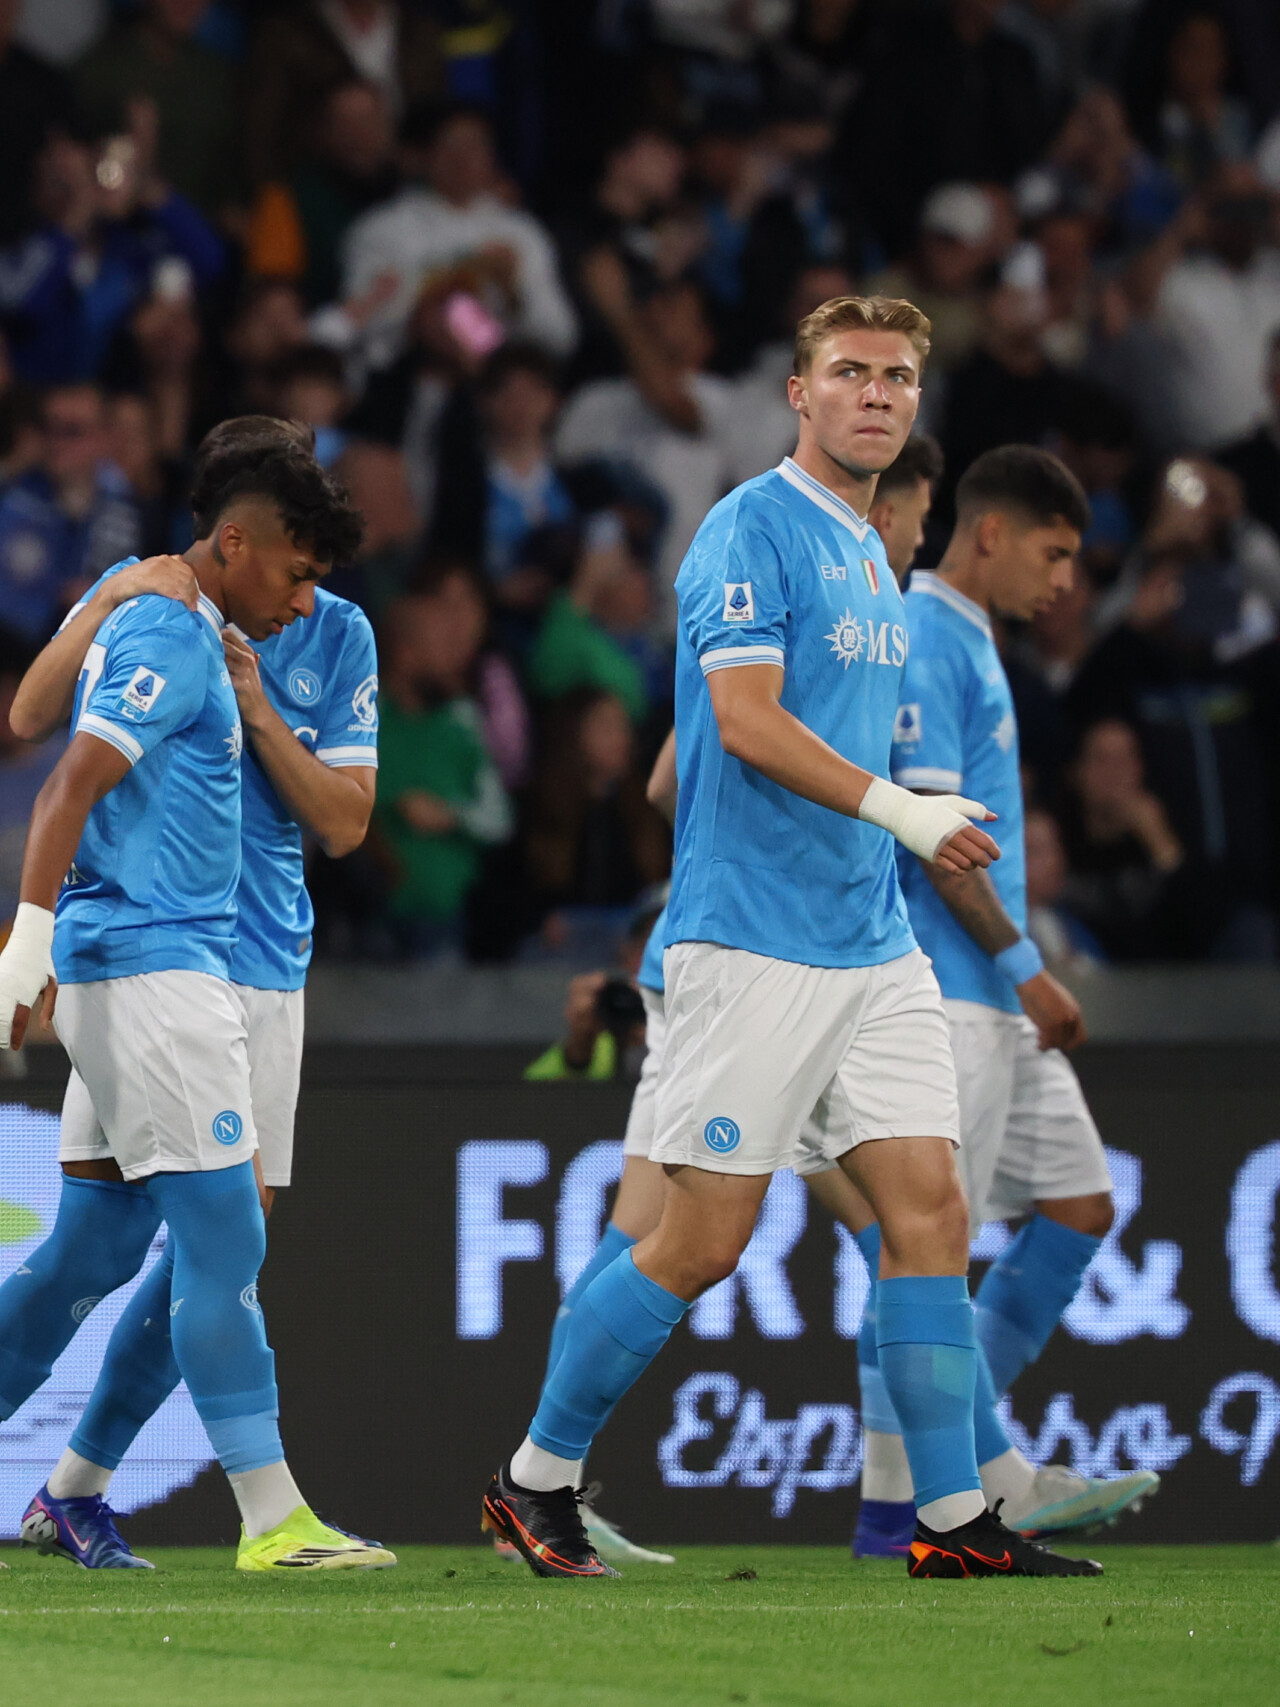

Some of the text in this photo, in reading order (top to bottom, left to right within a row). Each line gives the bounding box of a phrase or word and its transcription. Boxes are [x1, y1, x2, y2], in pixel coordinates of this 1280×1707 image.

[820, 564, 847, 581] EA7
[865, 619, 909, 668] MS
[219, 1118, 236, 1137] N
[713, 1125, 731, 1144] N
